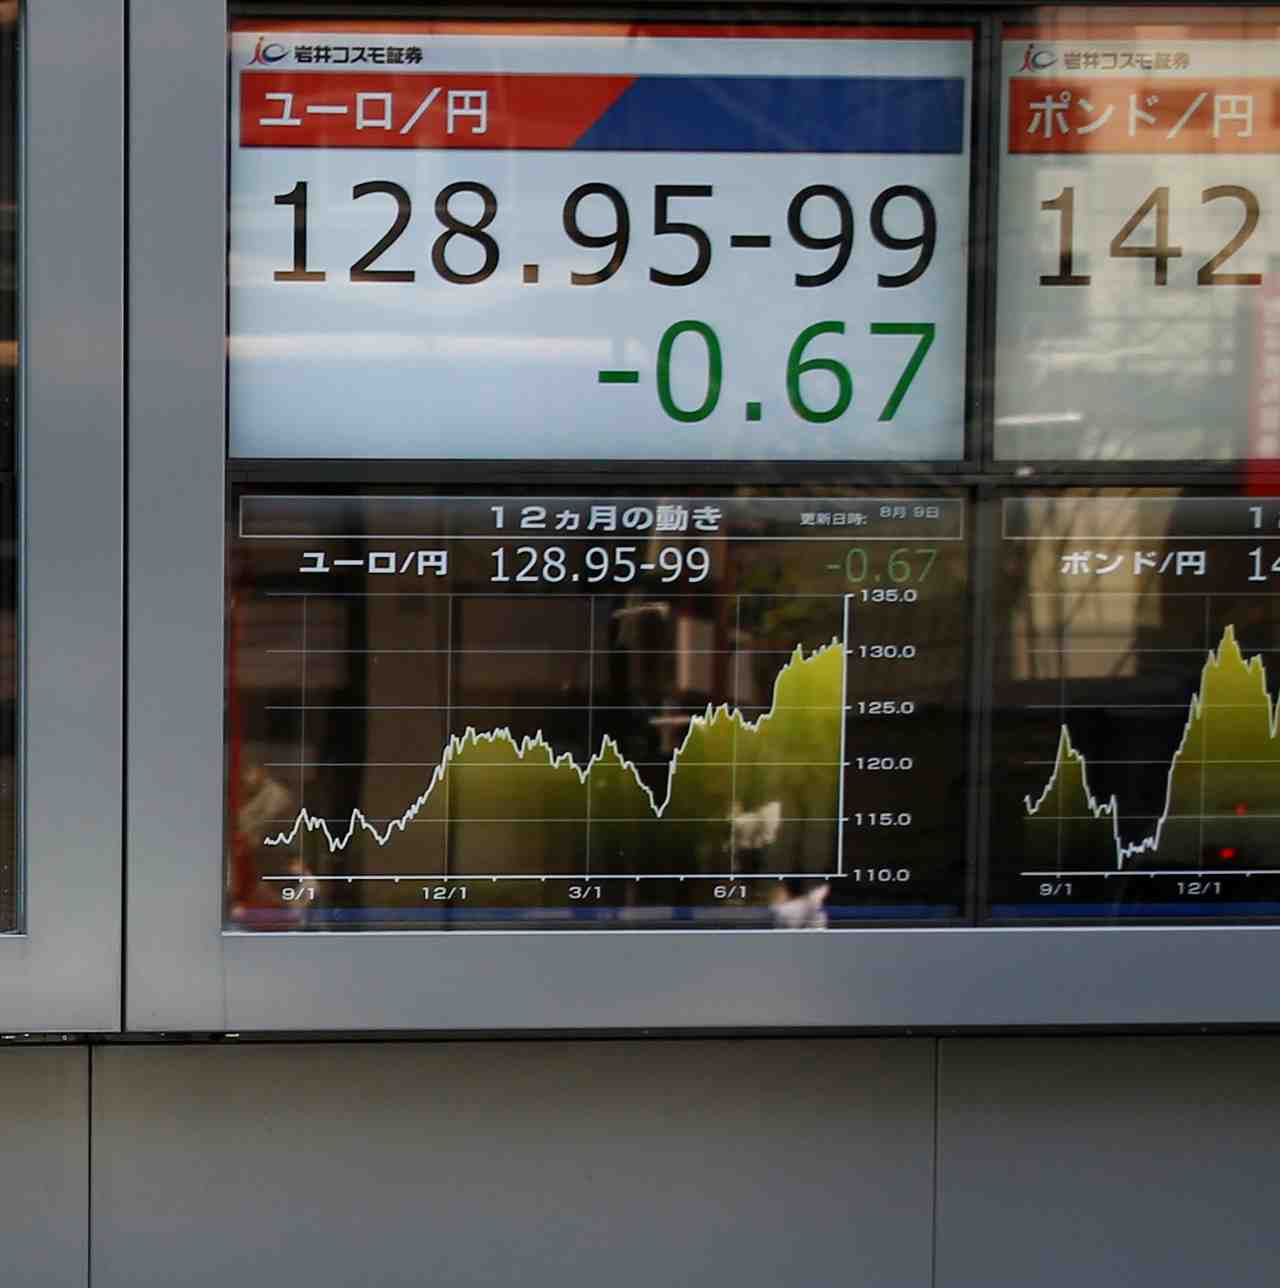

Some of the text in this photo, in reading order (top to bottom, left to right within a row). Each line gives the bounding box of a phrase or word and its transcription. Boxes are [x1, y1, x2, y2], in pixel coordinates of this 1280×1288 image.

[294, 46, 424, 64] 岩井コスモ証券
[273, 181, 937, 288] 128.95-99
[1039, 185, 1262, 287] 142
[598, 320, 937, 423] -0.67
[300, 548, 448, 577] ユーロ/円
[489, 546, 711, 585] 128.95-99
[825, 548, 937, 582] -0.67
[1061, 551, 1206, 576] ポンド/円
[860, 588, 918, 602] 135.0
[859, 645, 916, 658] 130.0
[857, 701, 914, 714] 125.0
[856, 757, 913, 770] 120.0
[854, 812, 912, 826] 115.0
[853, 868, 910, 882] 110.0
[282, 885, 747, 901] 9/1 12/1 3/1 6/1
[1039, 881, 1221, 897] 9/1 12/1
